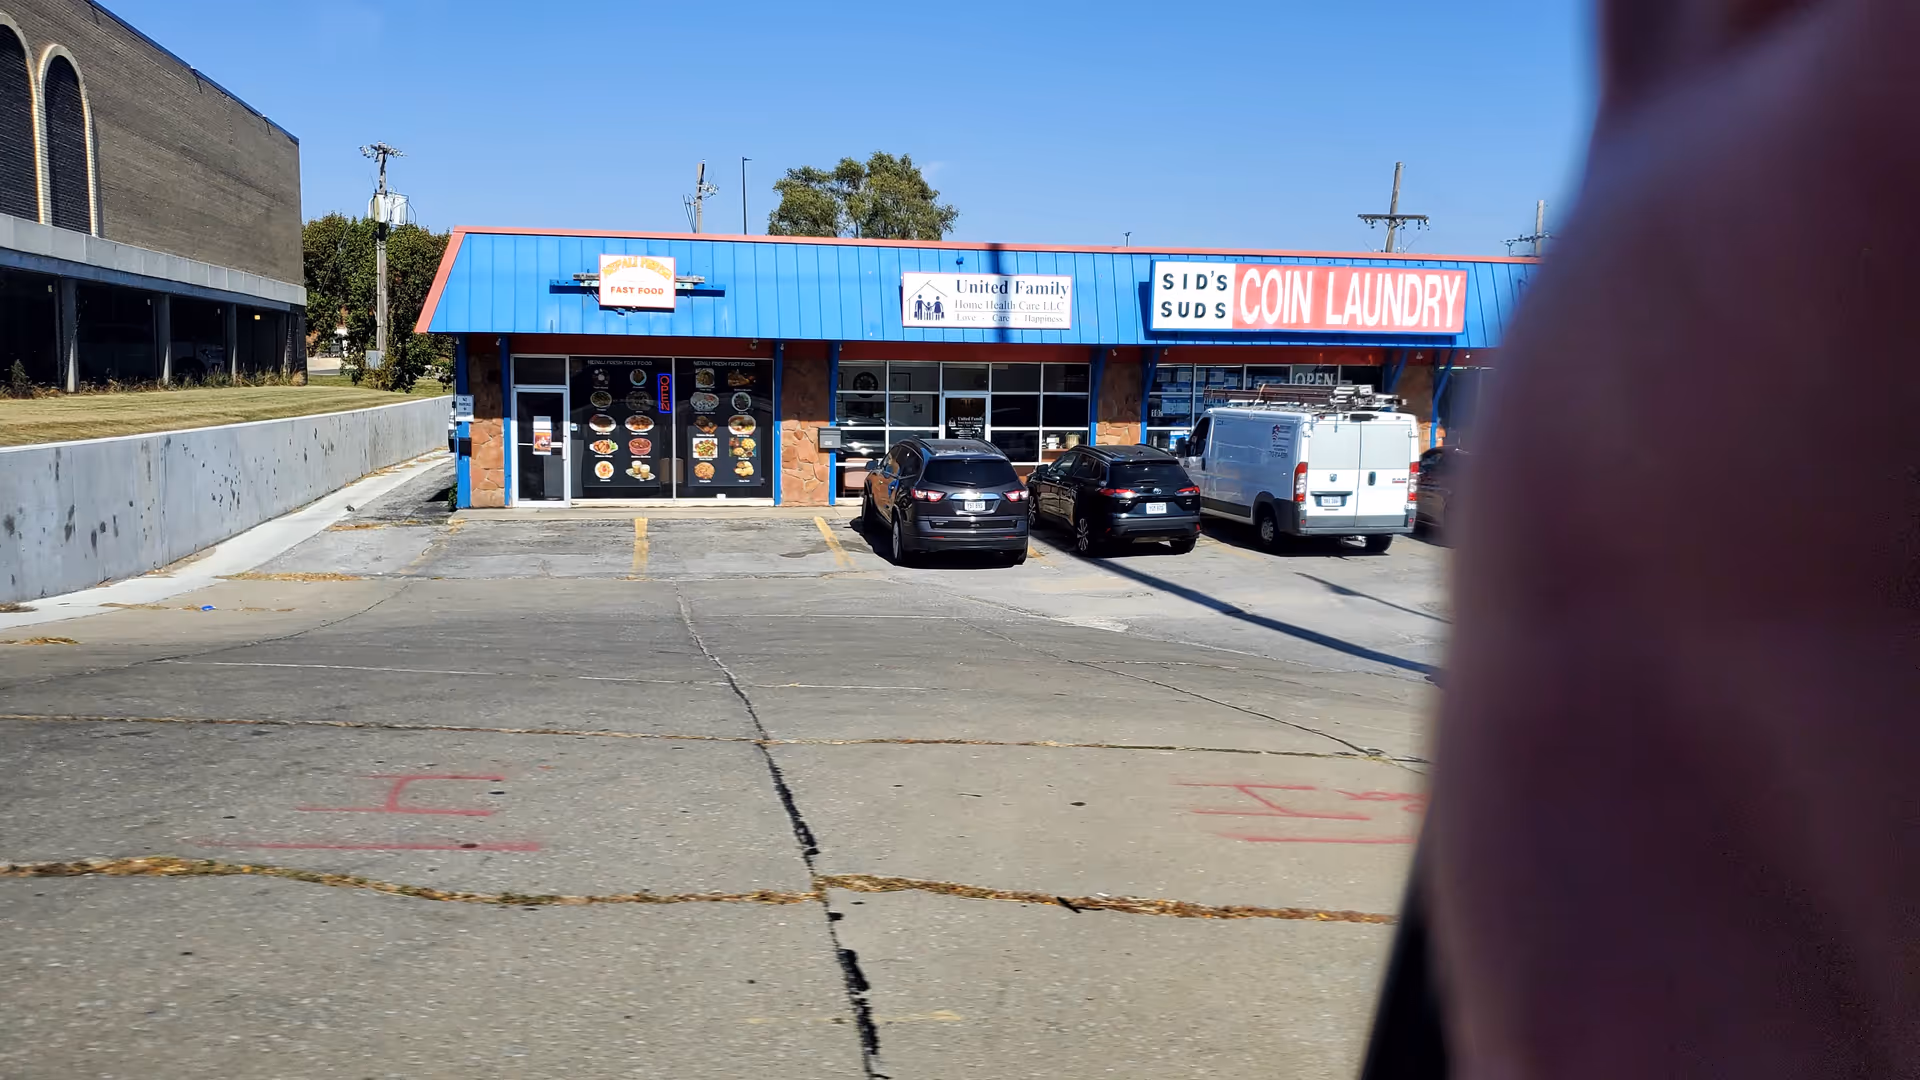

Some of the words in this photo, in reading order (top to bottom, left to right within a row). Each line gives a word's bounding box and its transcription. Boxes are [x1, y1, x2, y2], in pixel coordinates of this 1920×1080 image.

[956, 279, 1008, 295] United
[1015, 280, 1070, 299] Family
[1162, 270, 1228, 291] SID'S
[611, 286, 635, 295] FAST
[638, 287, 664, 295] FOOD
[1239, 268, 1312, 325] COIN
[1325, 271, 1462, 328] LAUNDRY
[955, 299, 983, 310] Home
[985, 300, 1016, 311] Health
[1018, 301, 1041, 311] Care
[1043, 302, 1064, 311] LLC
[1160, 300, 1227, 319] SUDS
[992, 313, 1010, 322] Care
[1295, 372, 1334, 385] OPEN
[660, 375, 670, 411] OPEN
